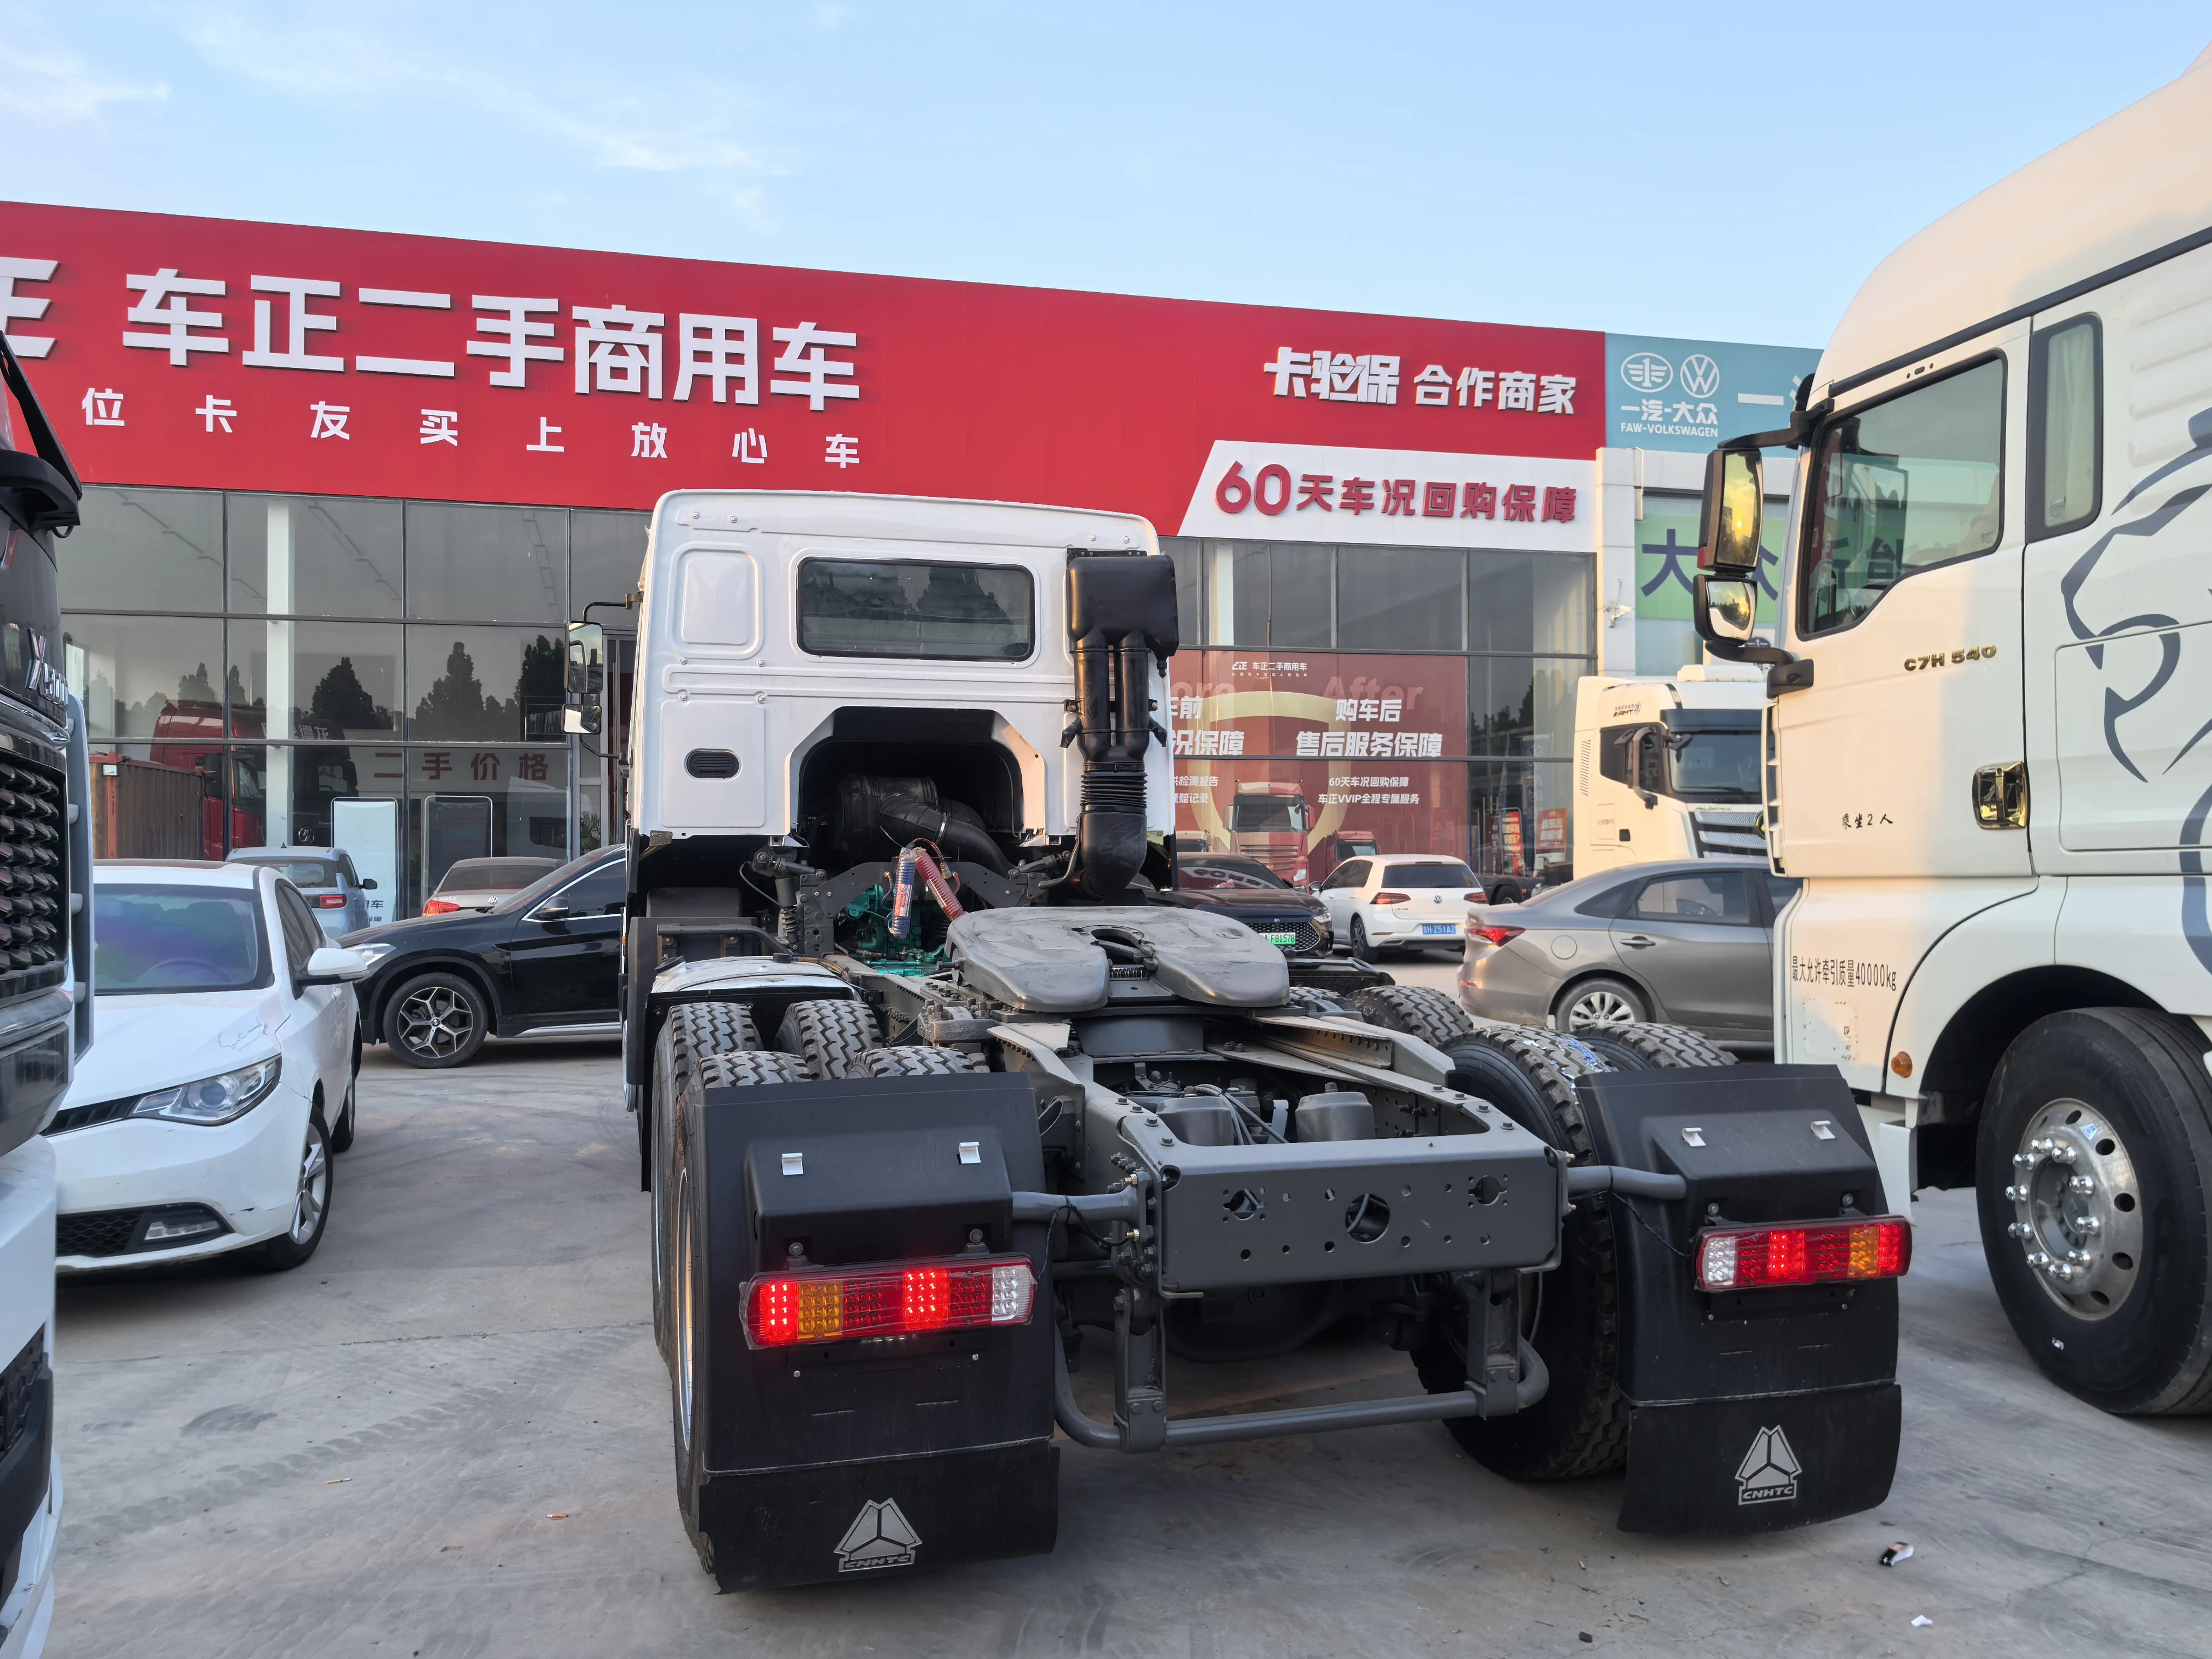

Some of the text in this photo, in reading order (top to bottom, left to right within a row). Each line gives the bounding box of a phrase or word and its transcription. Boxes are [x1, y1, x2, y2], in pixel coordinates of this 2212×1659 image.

[123, 268, 860, 412] 车正二手商用车
[1264, 346, 1576, 415] 卡验保 合作商家
[1621, 422, 1718, 437] FAW-VOLKSWAGEN
[1216, 461, 1577, 523] 60天车况回购保障
[1252, 662, 1307, 671] 车正二手商用车
[1904, 644, 1997, 671] C7H 540
[1324, 676, 1424, 710] After
[1336, 698, 1402, 722] 购车后
[1296, 731, 1443, 757] 售后服务保障
[374, 752, 548, 781] 二手价格
[1329, 777, 1409, 787] 60天车况回购保障
[1318, 793, 1420, 805] 车正VVIP全程专属服务
[367, 900, 384, 909] 车
[1792, 955, 1897, 992] 最大允许牵引质量40000kg
[1743, 1487, 1793, 1499] CNHTC
[845, 1555, 909, 1568] CNHTC
